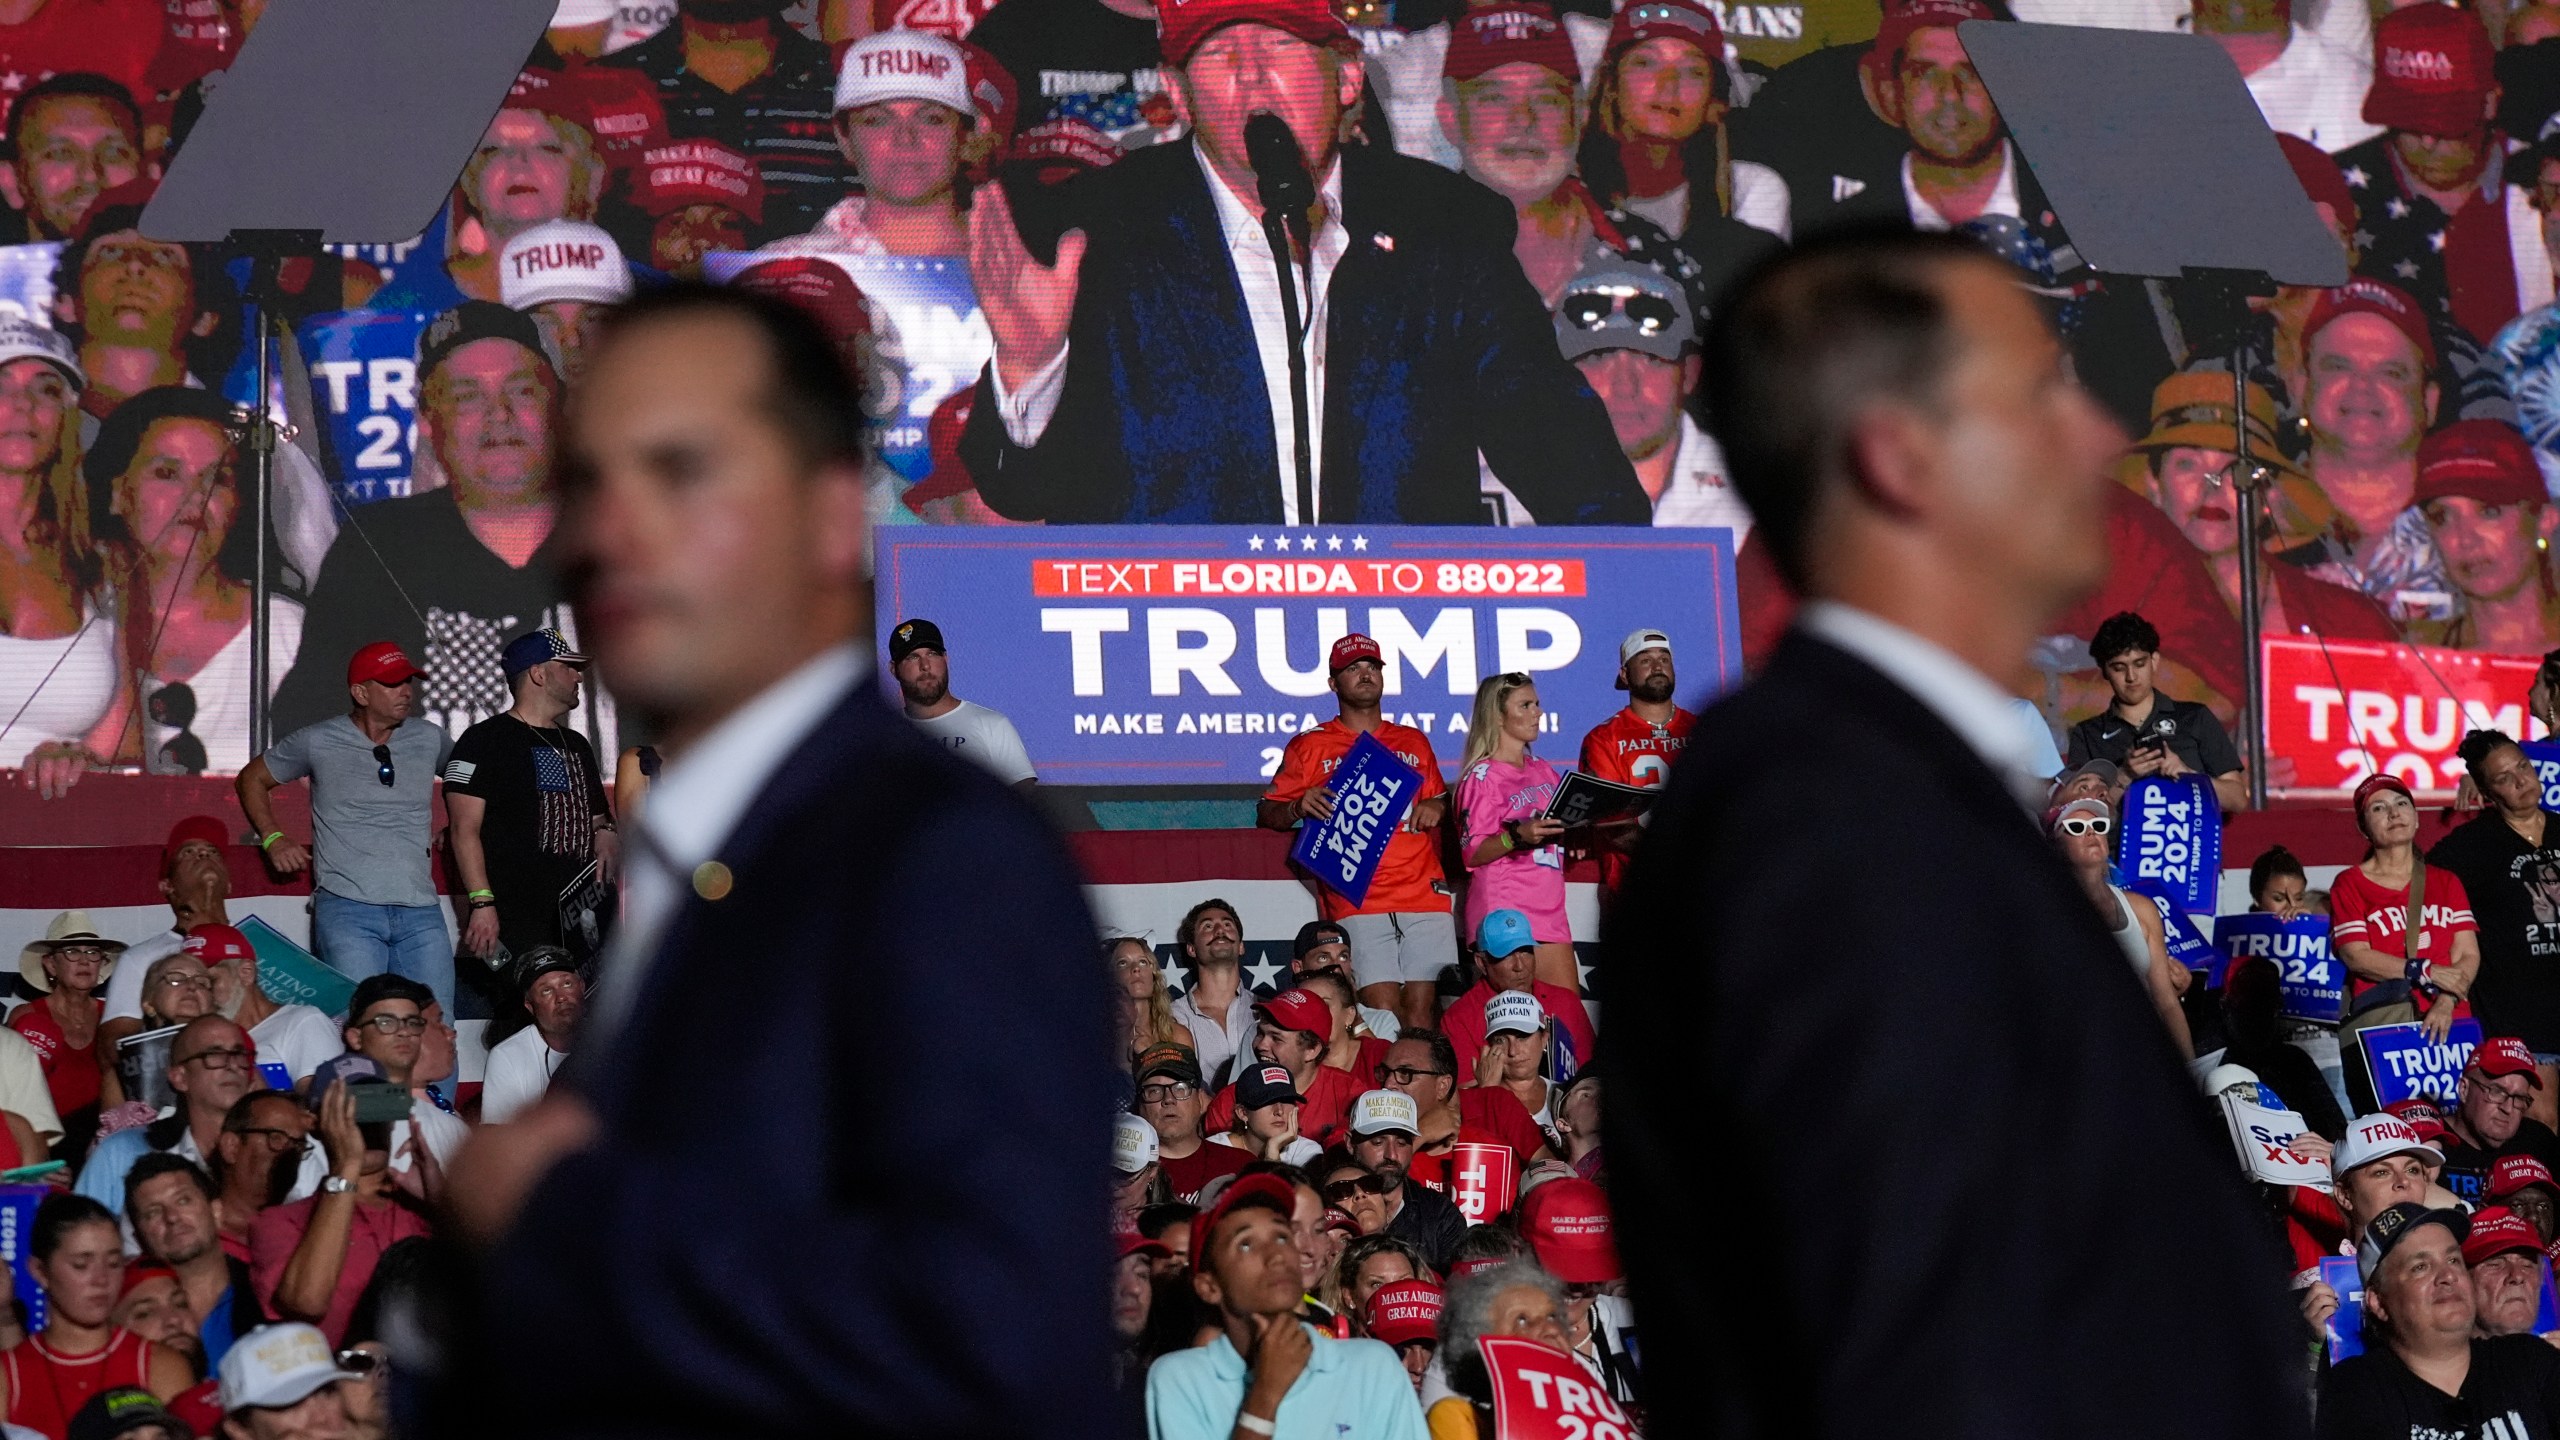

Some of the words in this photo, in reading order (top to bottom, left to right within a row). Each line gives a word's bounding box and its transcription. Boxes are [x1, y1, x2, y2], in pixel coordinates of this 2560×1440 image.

[859, 51, 951, 78] TRUMP
[511, 242, 605, 279] TRUMP
[311, 359, 416, 413] TR
[1053, 564, 1159, 592] TEXT
[1173, 563, 1357, 593] FLORIDA
[1369, 564, 1423, 593] TO
[1437, 563, 1565, 593] 88022
[1041, 607, 1582, 696] TRUMP
[1074, 714, 1164, 734] MAKE
[1176, 713, 1319, 734] AMERICA
[1618, 738, 1658, 756] PAPI
[1355, 752, 1371, 777] TEXT
[1333, 777, 1354, 812] TRUMP
[1327, 773, 1376, 855] 2024
[2193, 819, 2203, 833] TO
[1340, 776, 1402, 883] TRUMP
[2138, 784, 2167, 878] RUMP
[2162, 800, 2190, 884] 2024
[1310, 828, 1328, 859] 88022
[2190, 835, 2201, 873] TRUMP
[2188, 876, 2199, 902] TEXT
[2526, 924, 2541, 942] 2
[2227, 934, 2330, 960] TRUM
[2531, 942, 2560, 956] DEA
[255, 957, 317, 998] LATINO
[1501, 996, 1535, 1007] AMERICA
[2293, 986, 2310, 998] TO
[2312, 989, 2342, 1001] 8802
[1508, 1008, 1531, 1018] AGAIN
[2383, 1042, 2476, 1078] TRUMP
[2405, 1074, 2461, 1101] 202
[1366, 1097, 1385, 1107] MAKE
[1387, 1096, 1413, 1111] AMERICA
[1369, 1107, 1391, 1117] GREAT
[1392, 1107, 1410, 1120] AGAIN
[1115, 1126, 1143, 1143] MERICA
[2360, 1122, 2416, 1145] TRUMP
[2502, 1159, 2524, 1170] MAKE
[2509, 1168, 2532, 1180] GREAT
[1551, 1216, 1577, 1224] MAKE
[1553, 1225, 1584, 1234] GREAT
[1381, 1290, 1410, 1306] MAKE
[1411, 1290, 1443, 1306] AMERIC
[1387, 1306, 1418, 1321] GREAT
[1518, 1368, 1628, 1426] TRU
